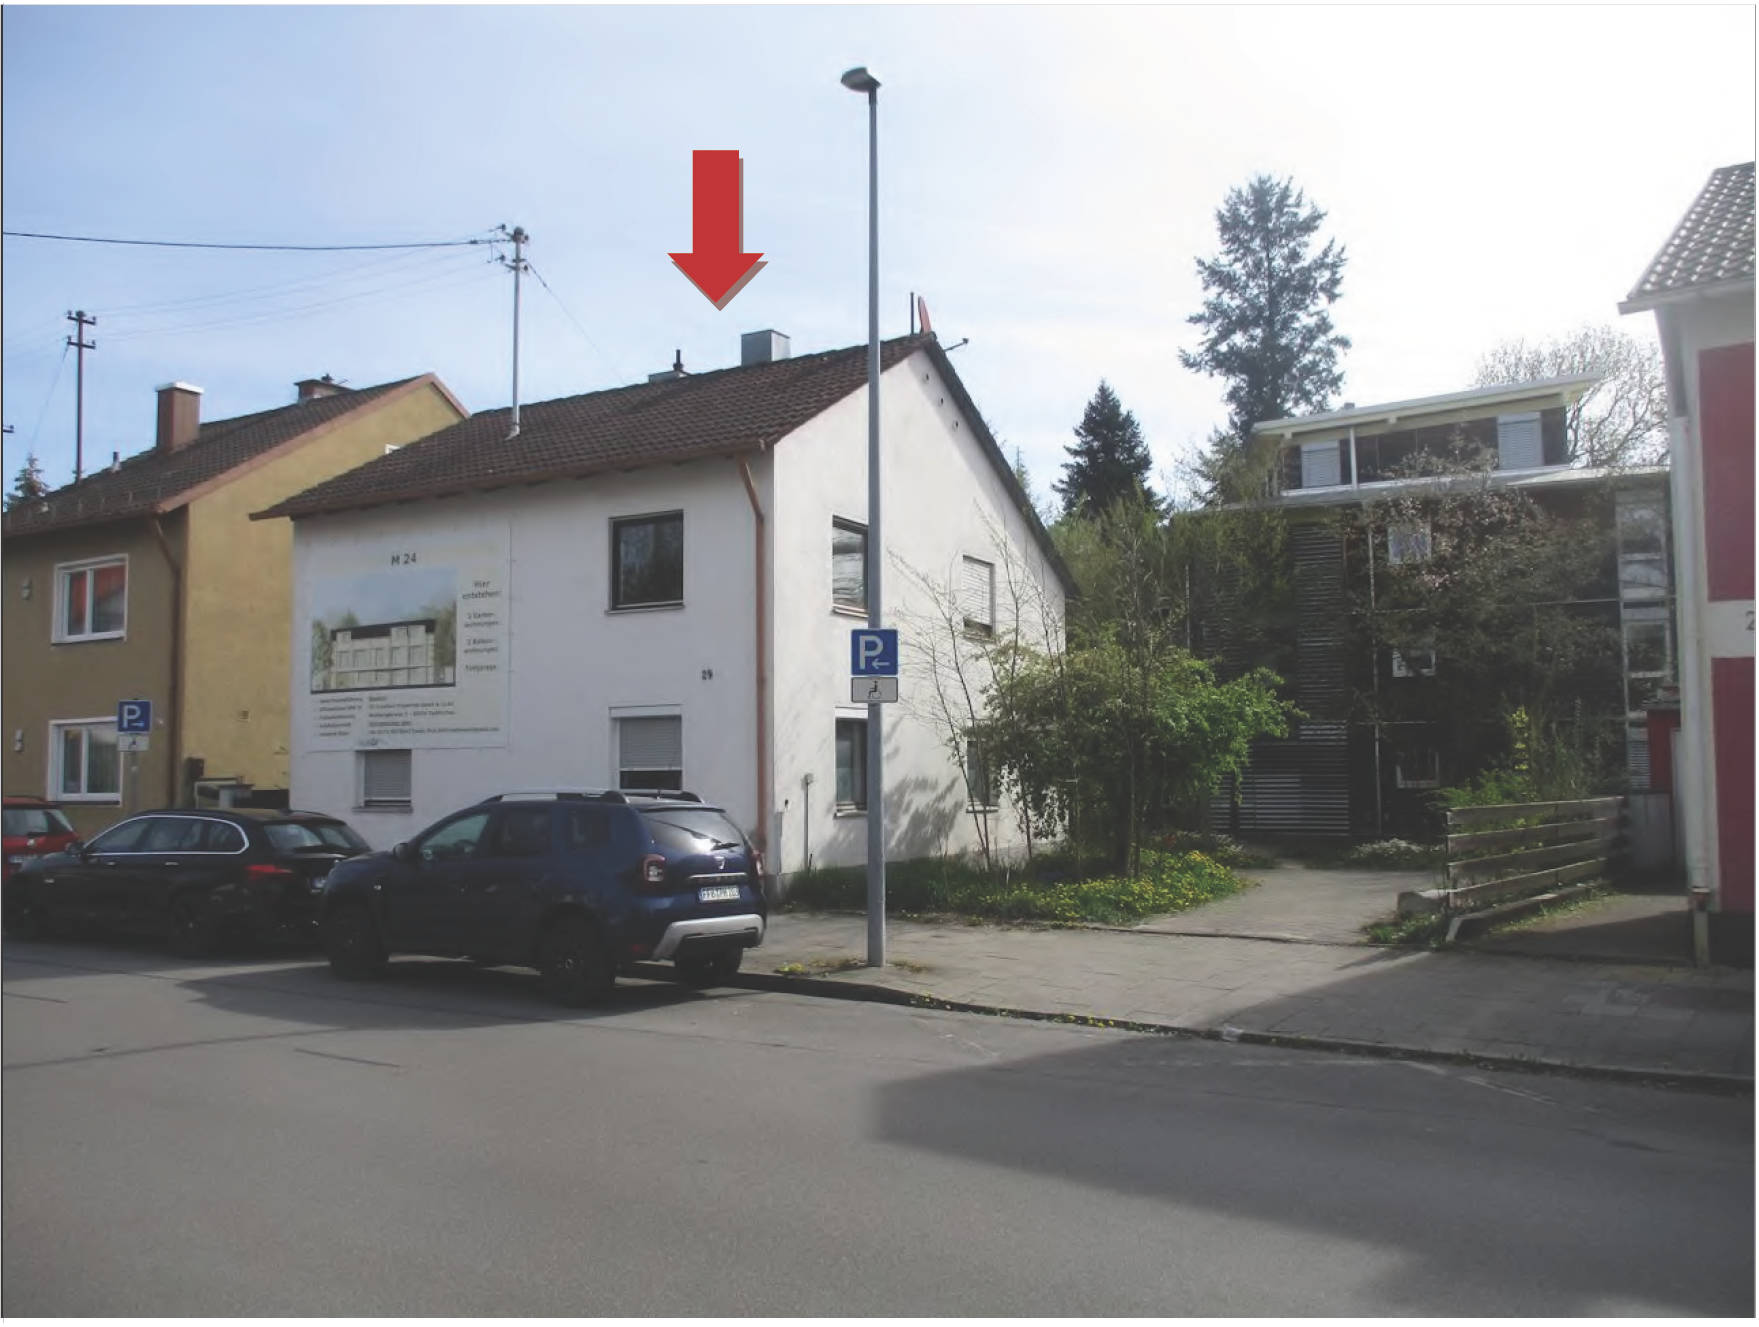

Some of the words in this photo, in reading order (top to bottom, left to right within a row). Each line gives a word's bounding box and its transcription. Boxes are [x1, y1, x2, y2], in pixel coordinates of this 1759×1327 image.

[391, 554, 401, 566] M
[403, 552, 417, 565] 24
[859, 634, 884, 670] P
[123, 704, 142, 729] P
